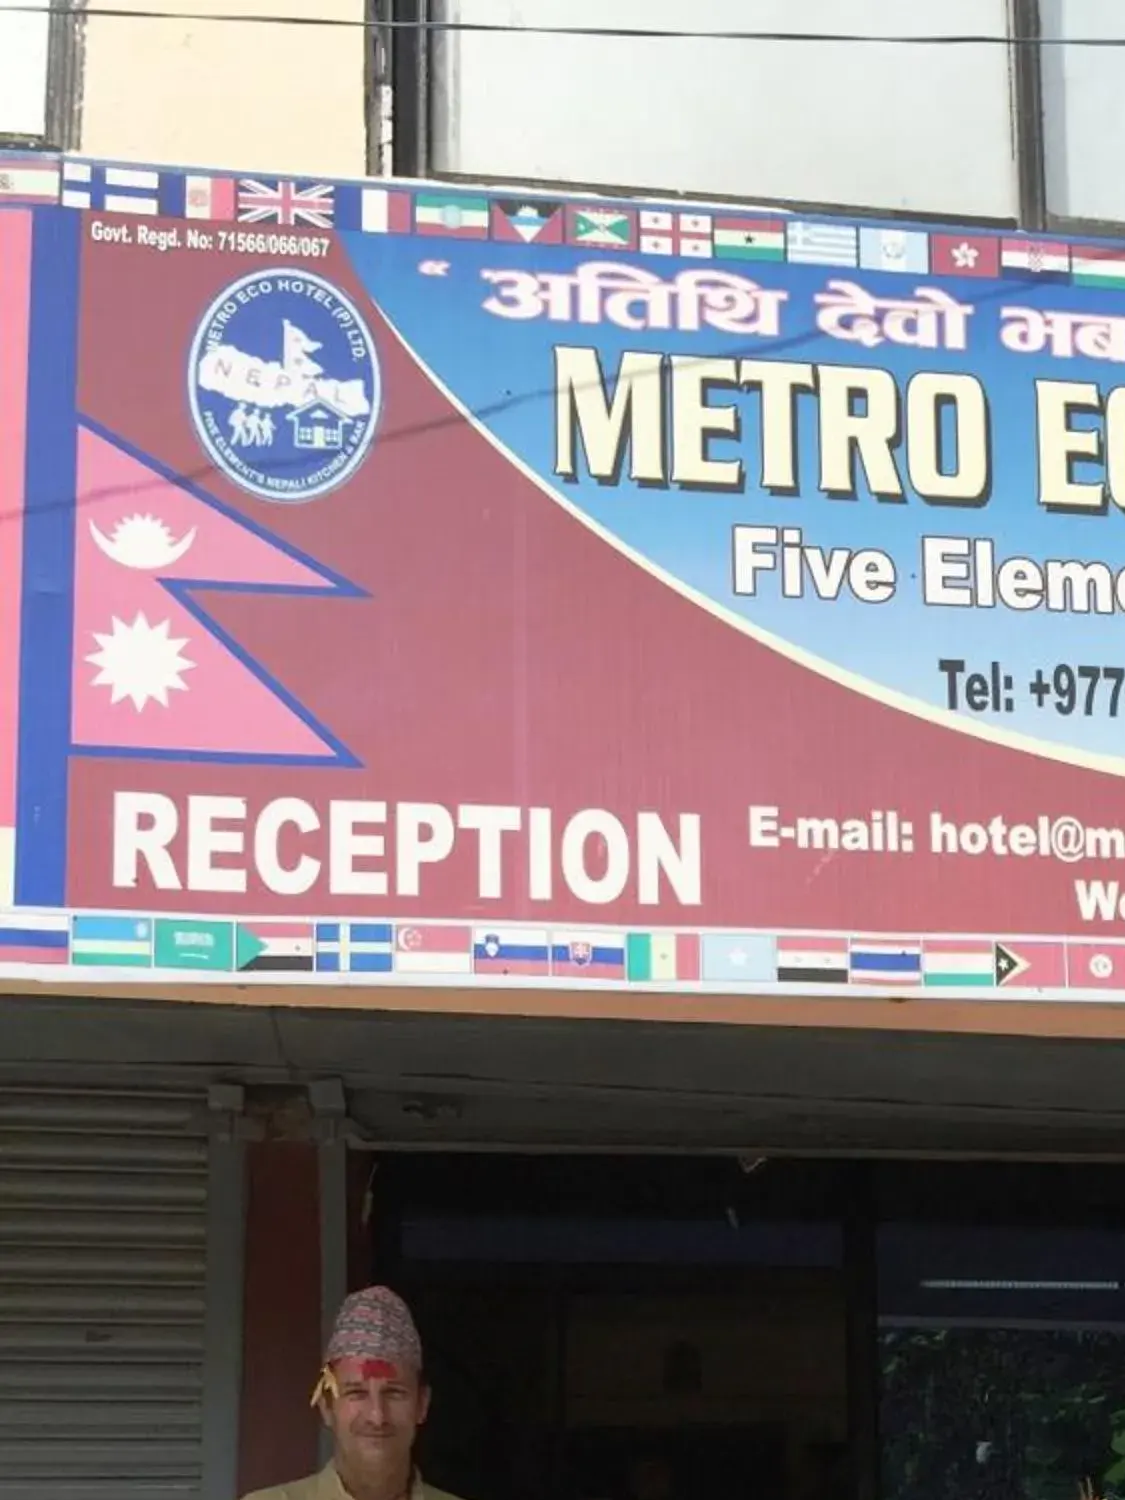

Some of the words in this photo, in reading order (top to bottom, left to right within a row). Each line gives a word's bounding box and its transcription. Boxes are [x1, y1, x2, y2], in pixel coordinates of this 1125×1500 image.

[91, 221, 132, 244] Govt.
[137, 225, 181, 251] Regd.
[187, 229, 213, 250] No:
[218, 232, 330, 257] 71566/066/067
[236, 281, 272, 304] ECO
[277, 279, 337, 309] HOTEL
[482, 260, 788, 336] अतिथि
[815, 279, 974, 350] देवो
[214, 358, 346, 404] NEPAL
[552, 346, 992, 506] METRO
[731, 524, 897, 602] Five
[938, 659, 1014, 712] Tel:
[111, 791, 703, 906] RECEPTION
[748, 805, 914, 854] E-mail:
